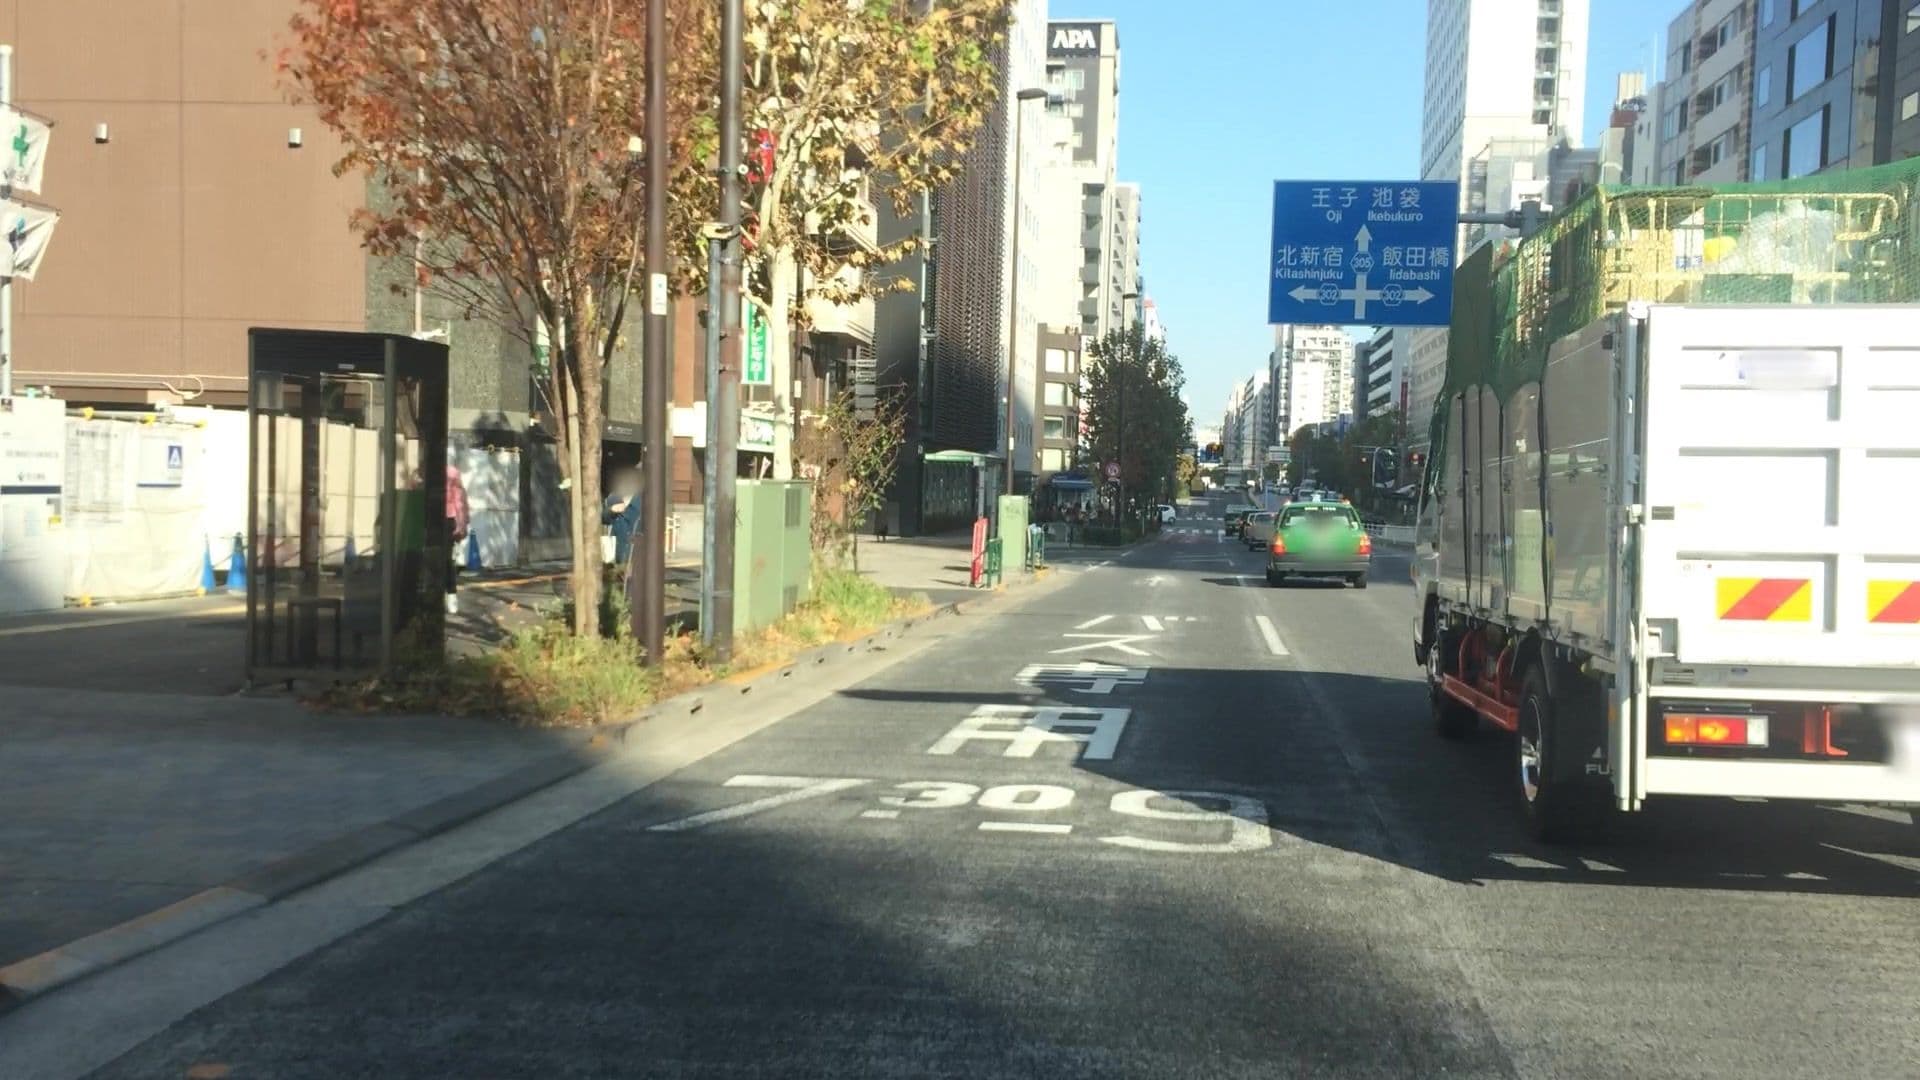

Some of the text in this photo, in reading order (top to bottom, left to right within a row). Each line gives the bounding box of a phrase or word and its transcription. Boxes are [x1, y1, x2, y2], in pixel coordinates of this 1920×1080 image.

[1052, 29, 1097, 49] APA
[1311, 187, 1421, 208] 王子 池袋
[1326, 210, 1424, 224] Oji Ikebukuro
[1277, 245, 1344, 267] 北新宿
[1353, 257, 1371, 268] 305
[1382, 246, 1449, 267] 飯田橋
[1275, 269, 1343, 281] Kitashinjuku
[1389, 269, 1440, 281] Iidabashi
[1585, 763, 1612, 776] FU
